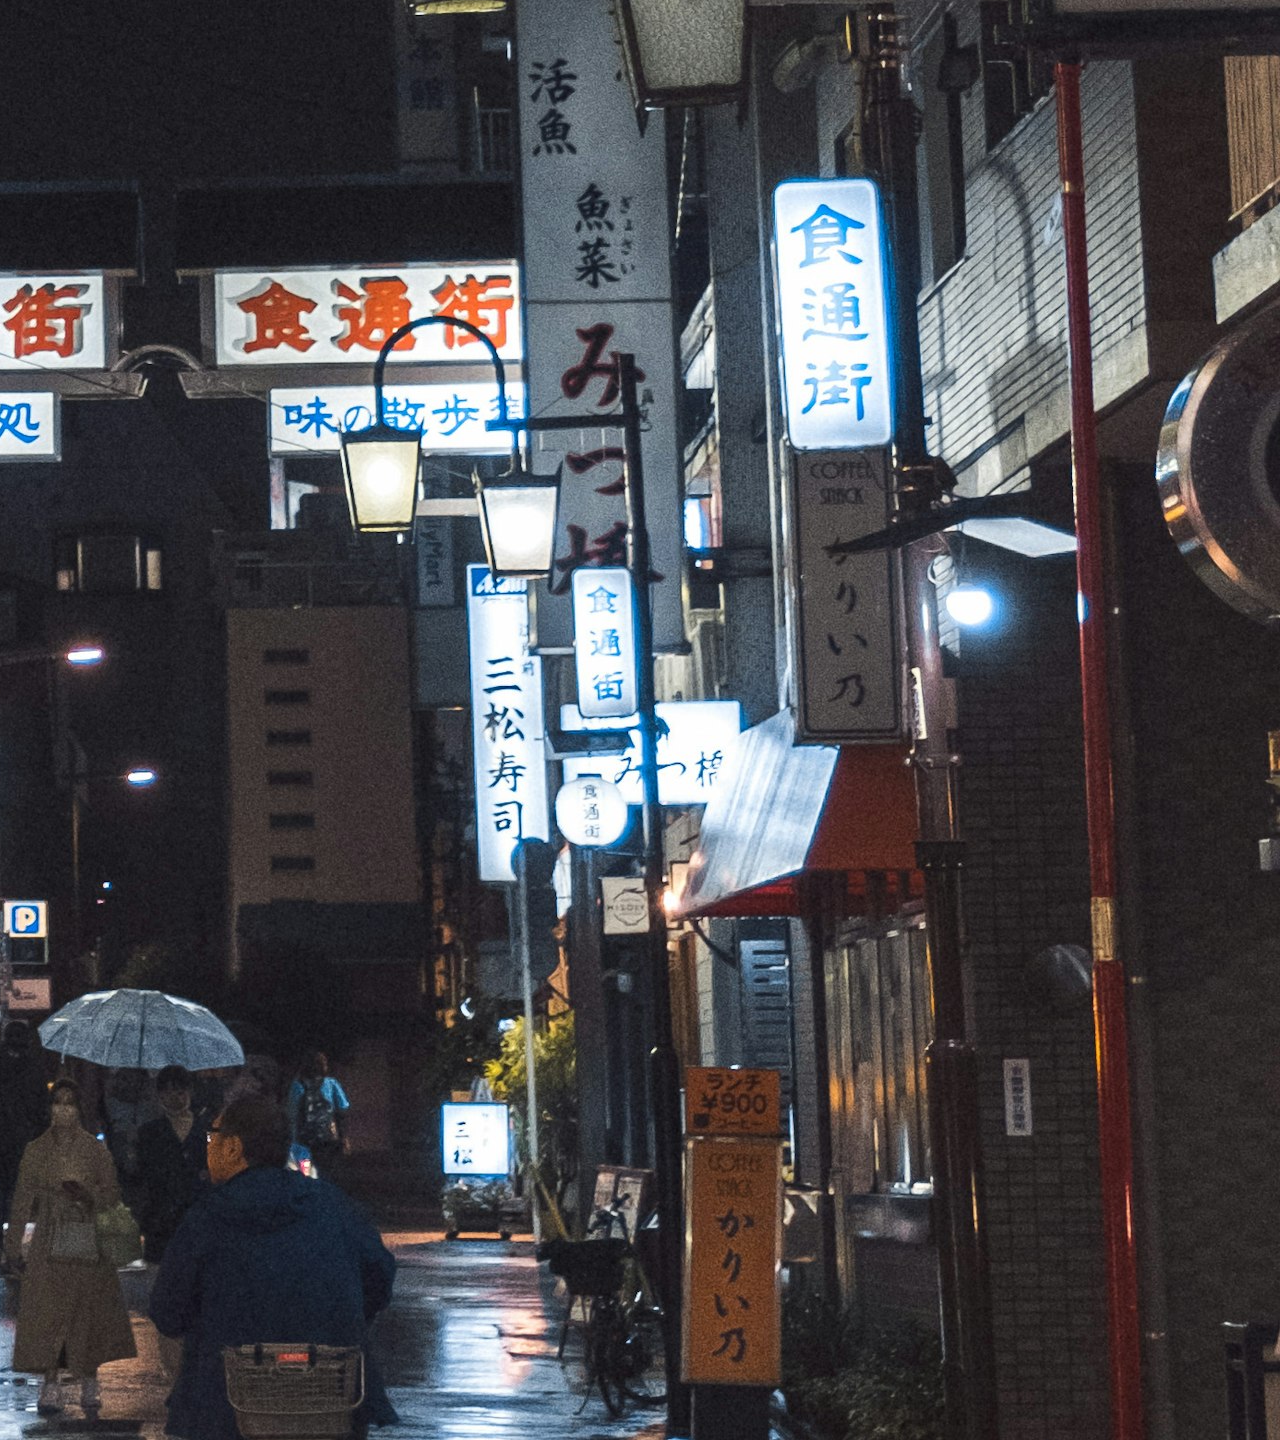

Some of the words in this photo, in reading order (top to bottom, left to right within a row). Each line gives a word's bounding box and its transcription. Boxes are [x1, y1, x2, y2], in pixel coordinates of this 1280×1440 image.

[527, 58, 578, 156] 活魚
[574, 182, 620, 289] 魚菜
[237, 273, 515, 355] 食通街
[790, 204, 873, 422] 食通街
[586, 584, 625, 704] 食通街
[483, 656, 527, 838] 三松寿司
[581, 784, 601, 839] 食通街
[14, 906, 37, 932] P
[702, 1092, 768, 1115] ¥900
[706, 1073, 762, 1091] ランチ
[712, 1207, 758, 1364] かりい乃
